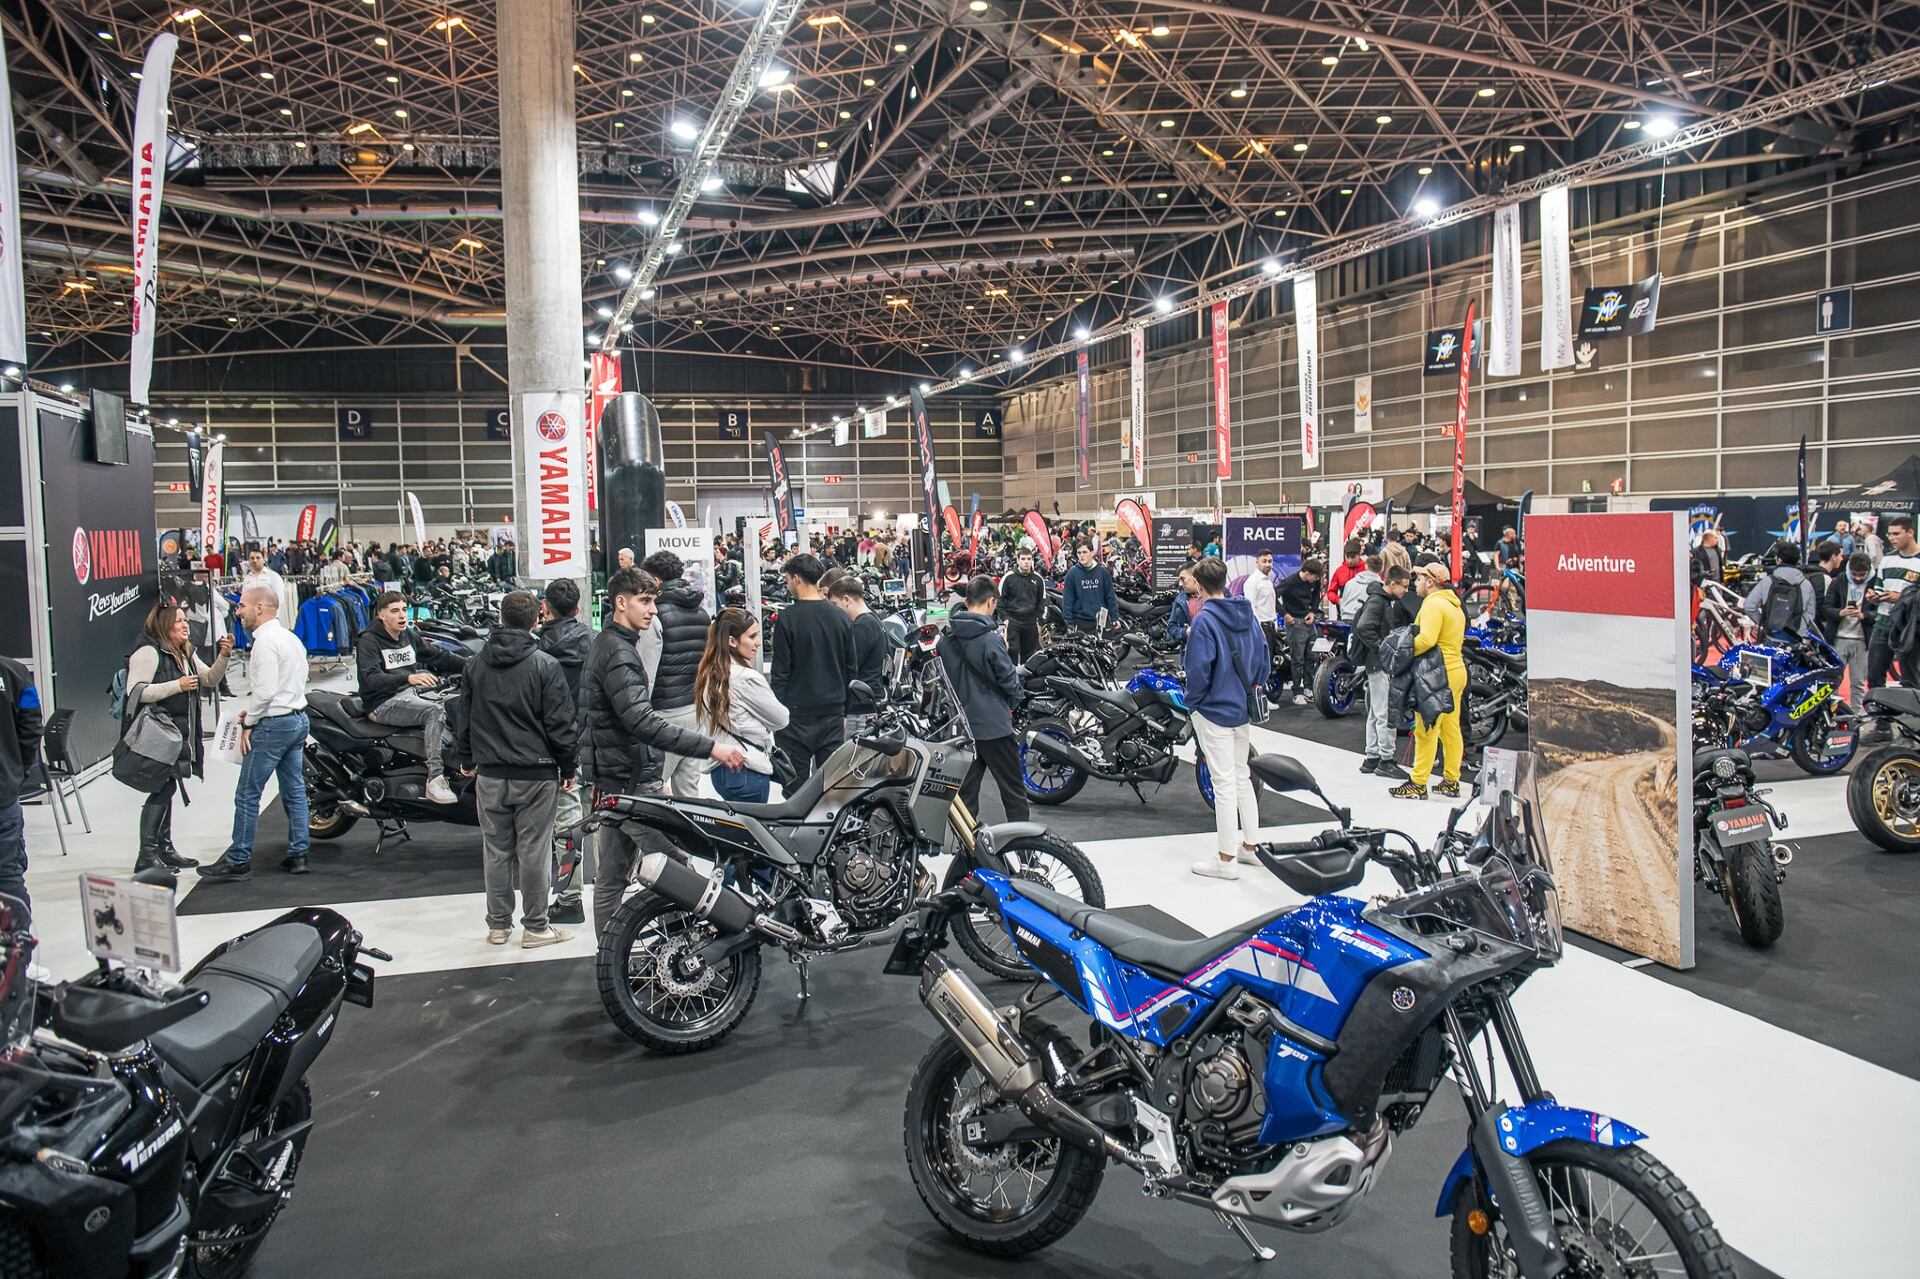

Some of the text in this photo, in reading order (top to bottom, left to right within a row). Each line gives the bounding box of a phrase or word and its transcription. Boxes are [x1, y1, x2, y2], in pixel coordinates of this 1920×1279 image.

[348, 410, 361, 425] D
[497, 411, 508, 426] C
[728, 413, 738, 426] B
[982, 412, 994, 425] A
[539, 446, 571, 565] YAMAHA
[1840, 501, 1870, 510] AGUSTA
[205, 484, 217, 546] KYMCO
[1243, 527, 1285, 541] RACE
[658, 537, 701, 548] MOVE
[88, 529, 143, 580] YAMAHA
[1557, 553, 1636, 573] Adventure
[692, 814, 716, 825] YAMAHA
[1727, 814, 1766, 829] YAMAHA
[1015, 926, 1042, 949] YAMAHA
[1277, 1044, 1309, 1061] 700
